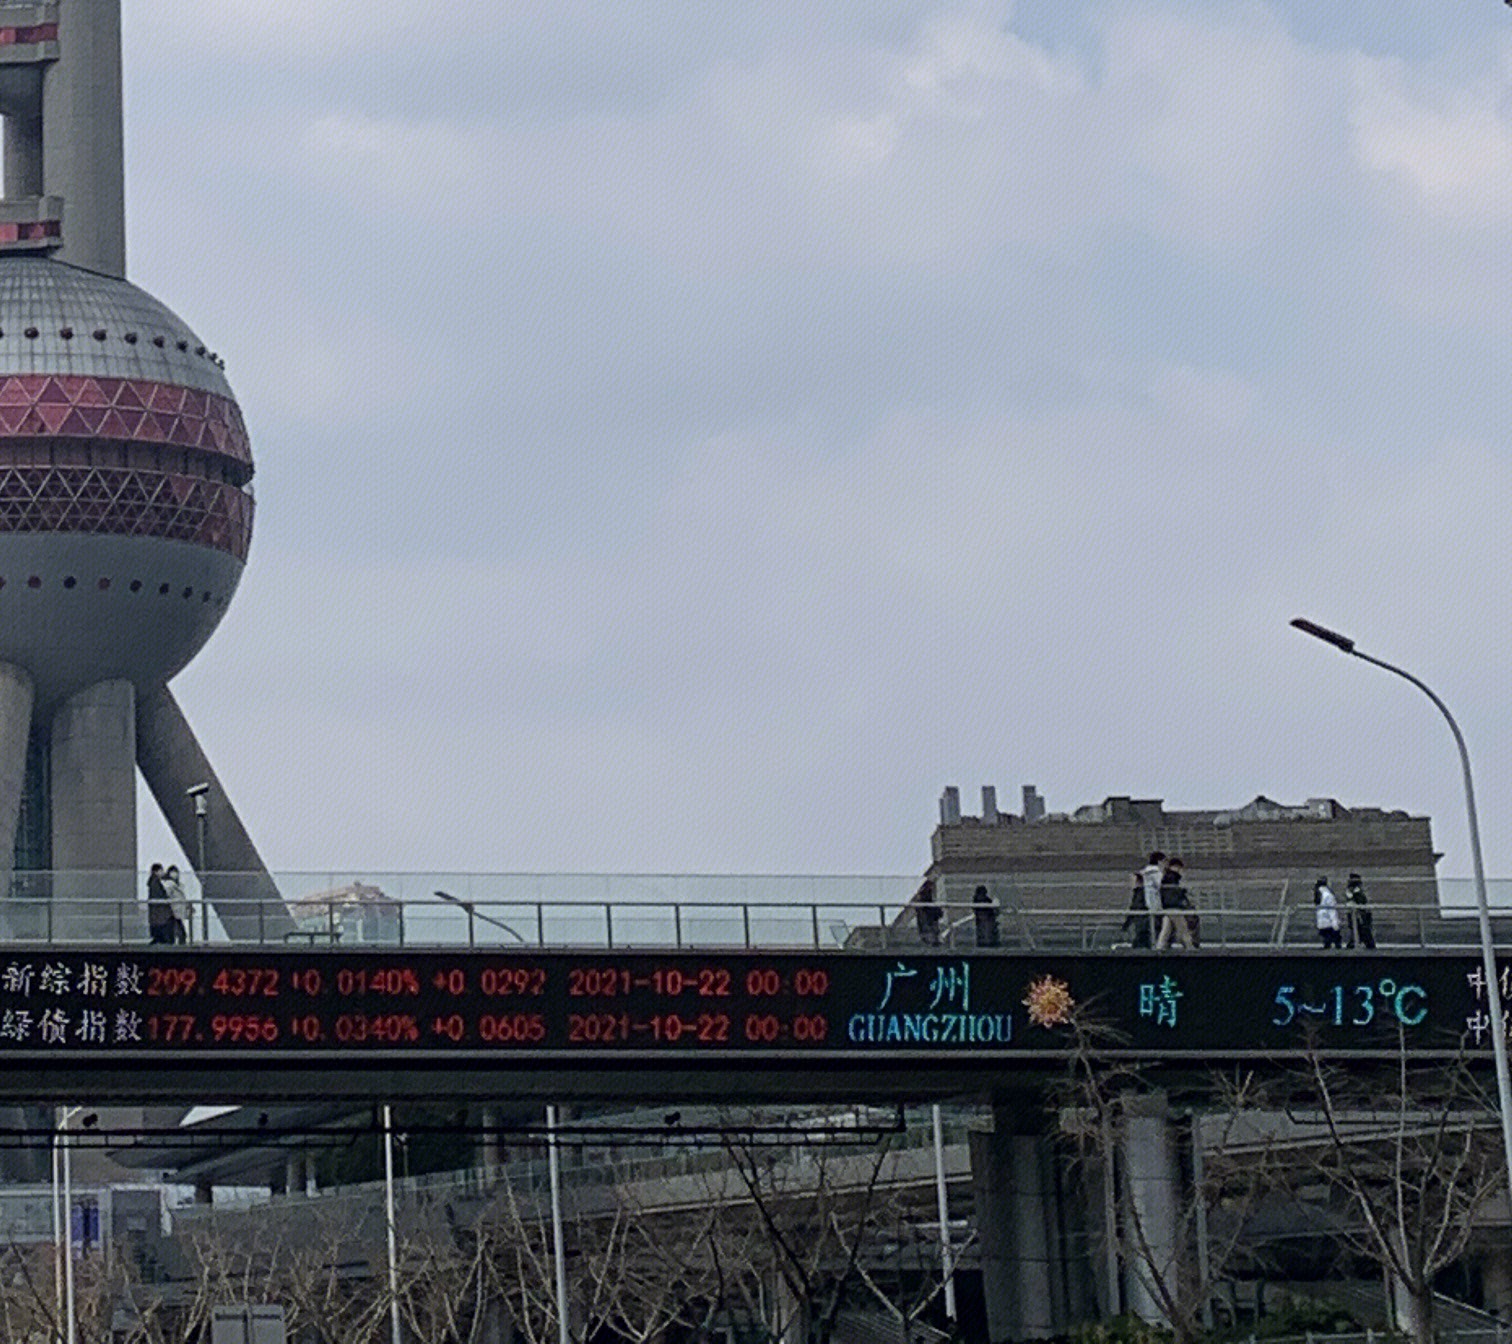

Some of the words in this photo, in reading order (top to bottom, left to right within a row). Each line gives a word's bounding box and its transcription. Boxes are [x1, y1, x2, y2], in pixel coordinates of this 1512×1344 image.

[147, 968, 280, 996] 209.4372
[569, 968, 731, 996] 2021-10-22
[745, 969, 829, 996] 00:00
[877, 960, 970, 1011] 广州
[1138, 975, 1184, 1028] 晴
[147, 1015, 279, 1042] 177.9956
[568, 1015, 730, 1042] 2021-10-22
[744, 1015, 827, 1042] 00:00
[847, 1013, 1013, 1043] GUANGZHOU
